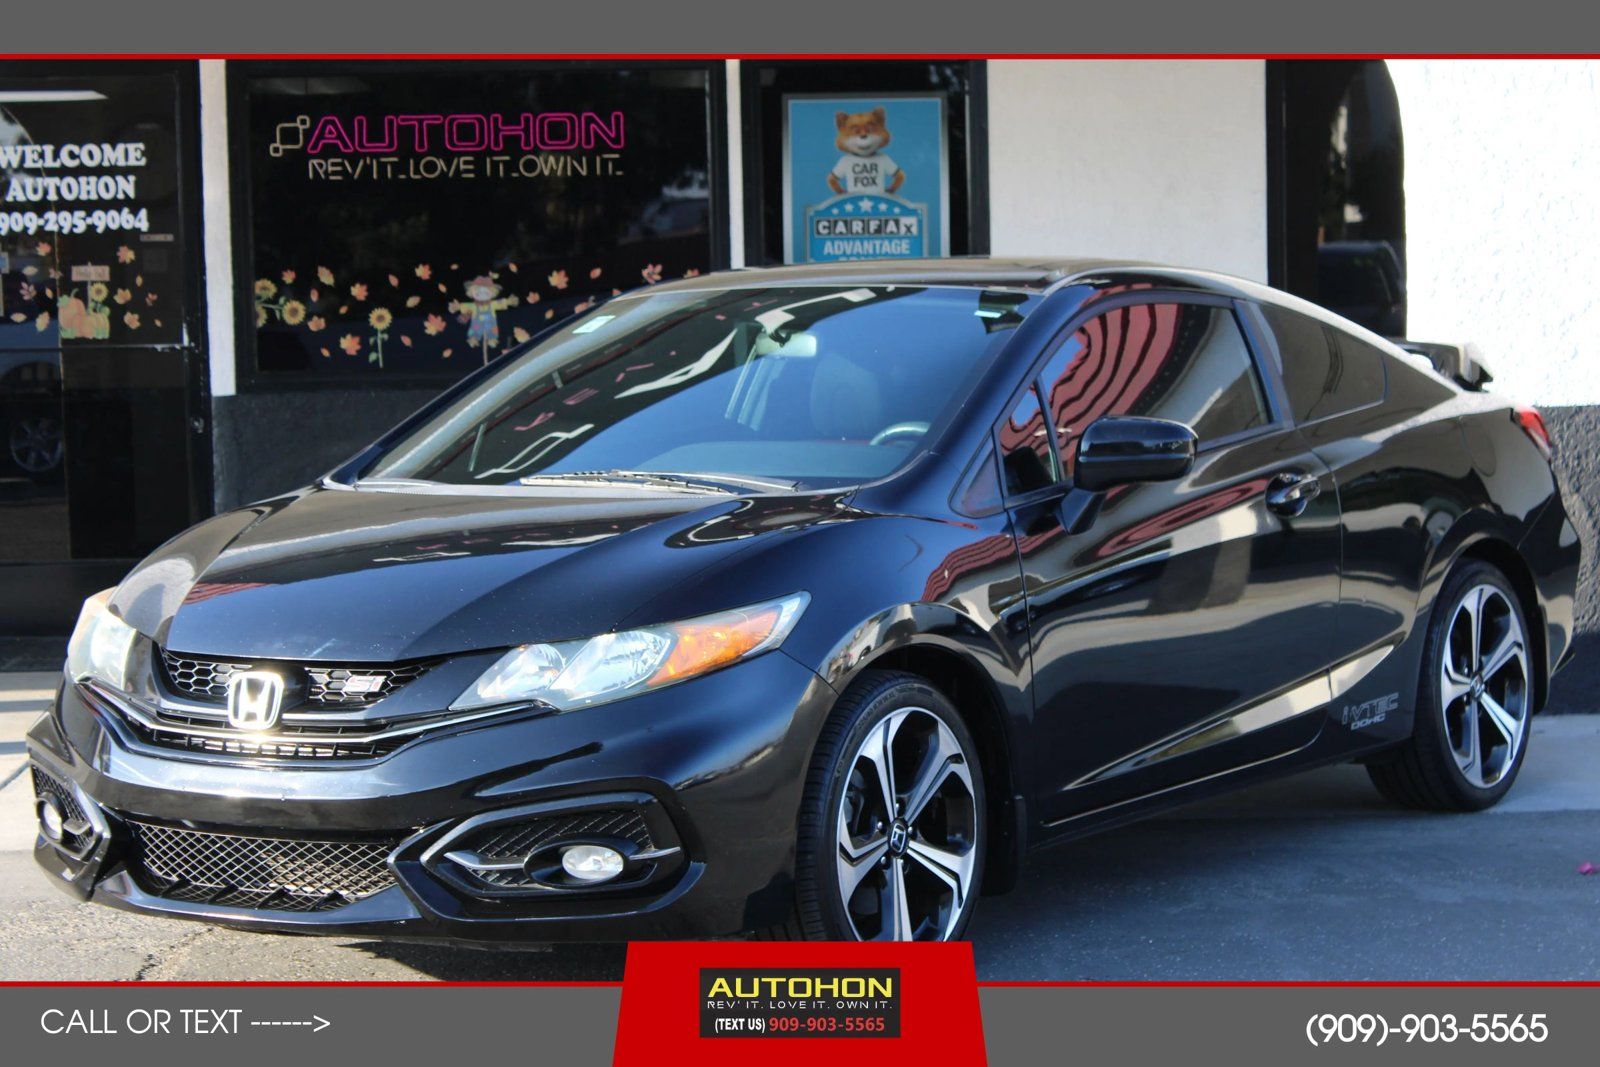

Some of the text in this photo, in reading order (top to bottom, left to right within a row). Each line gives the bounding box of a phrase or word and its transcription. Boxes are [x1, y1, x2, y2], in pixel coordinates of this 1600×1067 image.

[307, 111, 625, 153] AUTOHON
[0, 142, 147, 169] WELCOME
[409, 155, 476, 179] LOVE
[519, 154, 588, 178] OWN
[851, 162, 879, 176] CAR
[853, 175, 879, 188] FOX
[5, 174, 137, 202] AUTOHON
[0, 206, 150, 236] 909-295-9064
[816, 217, 917, 236] CARFAX
[823, 239, 911, 256] ADVANTAGE
